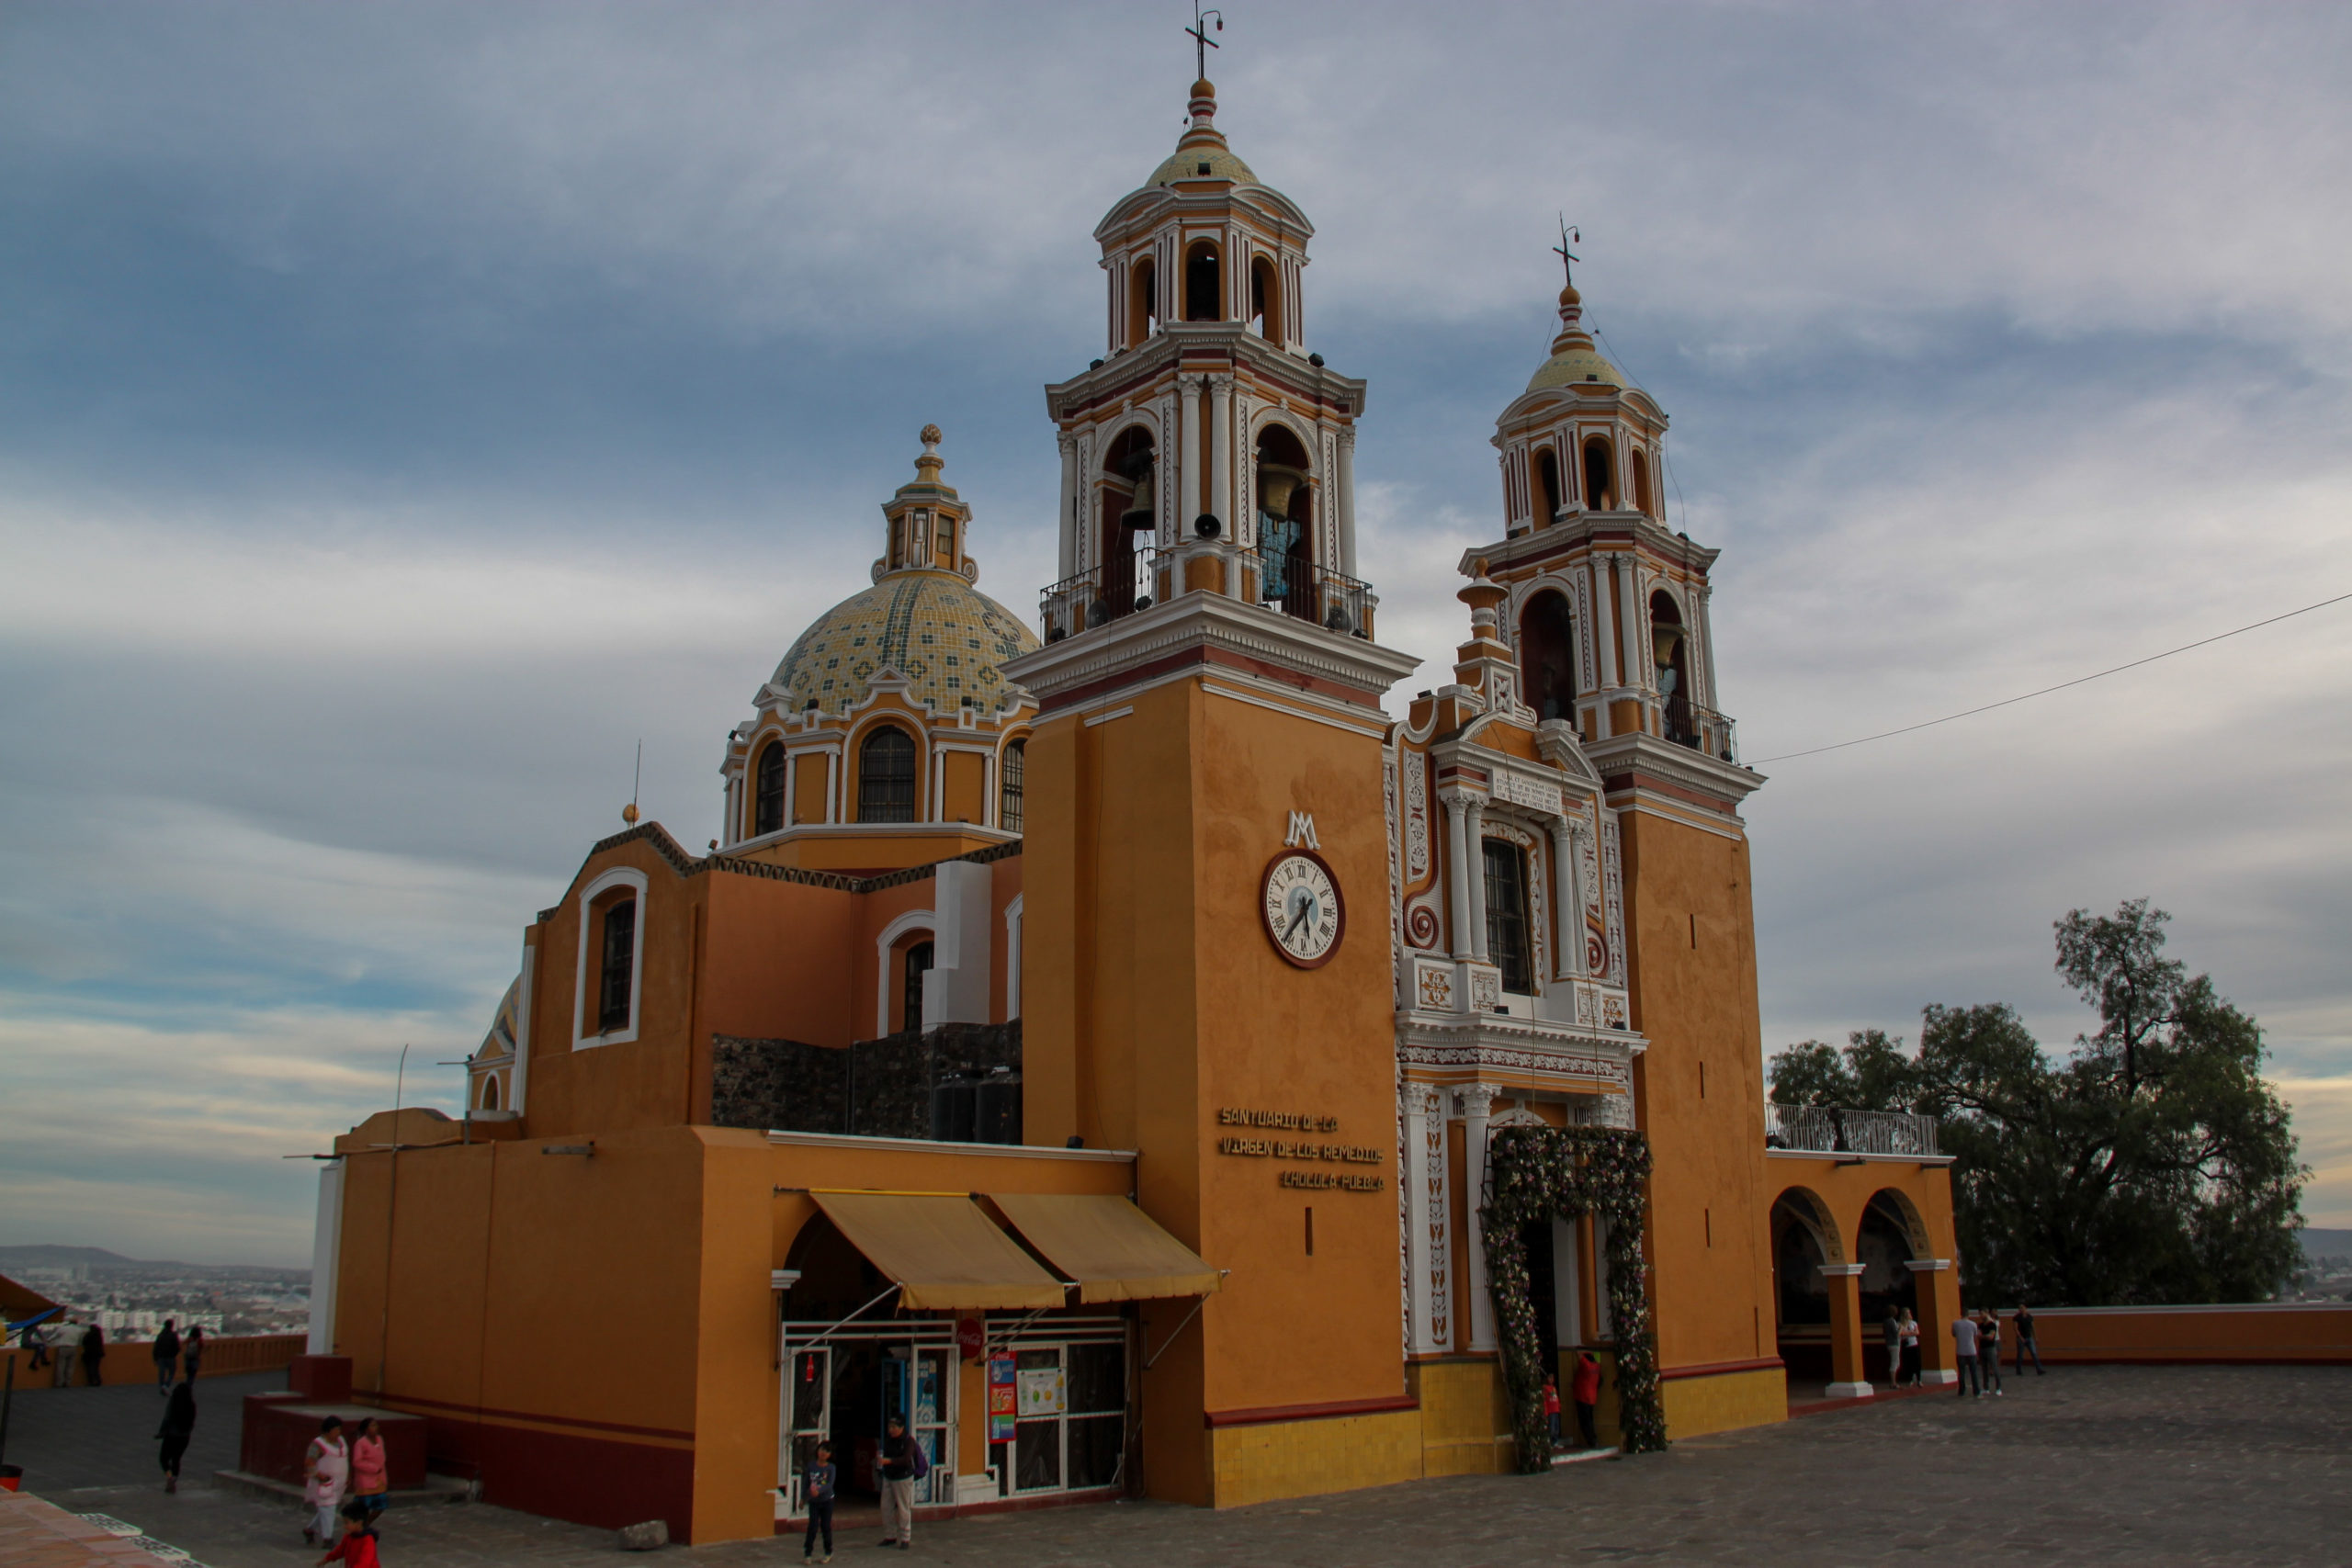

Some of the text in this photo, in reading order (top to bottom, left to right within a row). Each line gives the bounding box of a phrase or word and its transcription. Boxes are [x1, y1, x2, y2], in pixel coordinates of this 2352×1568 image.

[1283, 867, 1294, 882] XI
[1297, 864, 1306, 878] XII
[1274, 880, 1285, 892] X
[1319, 888, 1329, 897] II
[1272, 899, 1282, 908] IX
[1323, 908, 1332, 917] III
[1222, 1108, 1339, 1132] SANTUARIO DE LA
[1223, 1137, 1385, 1162] VIRGEN DE LOS REMEDIOS
[1283, 1170, 1385, 1191] CHOLULA PUEBLA
